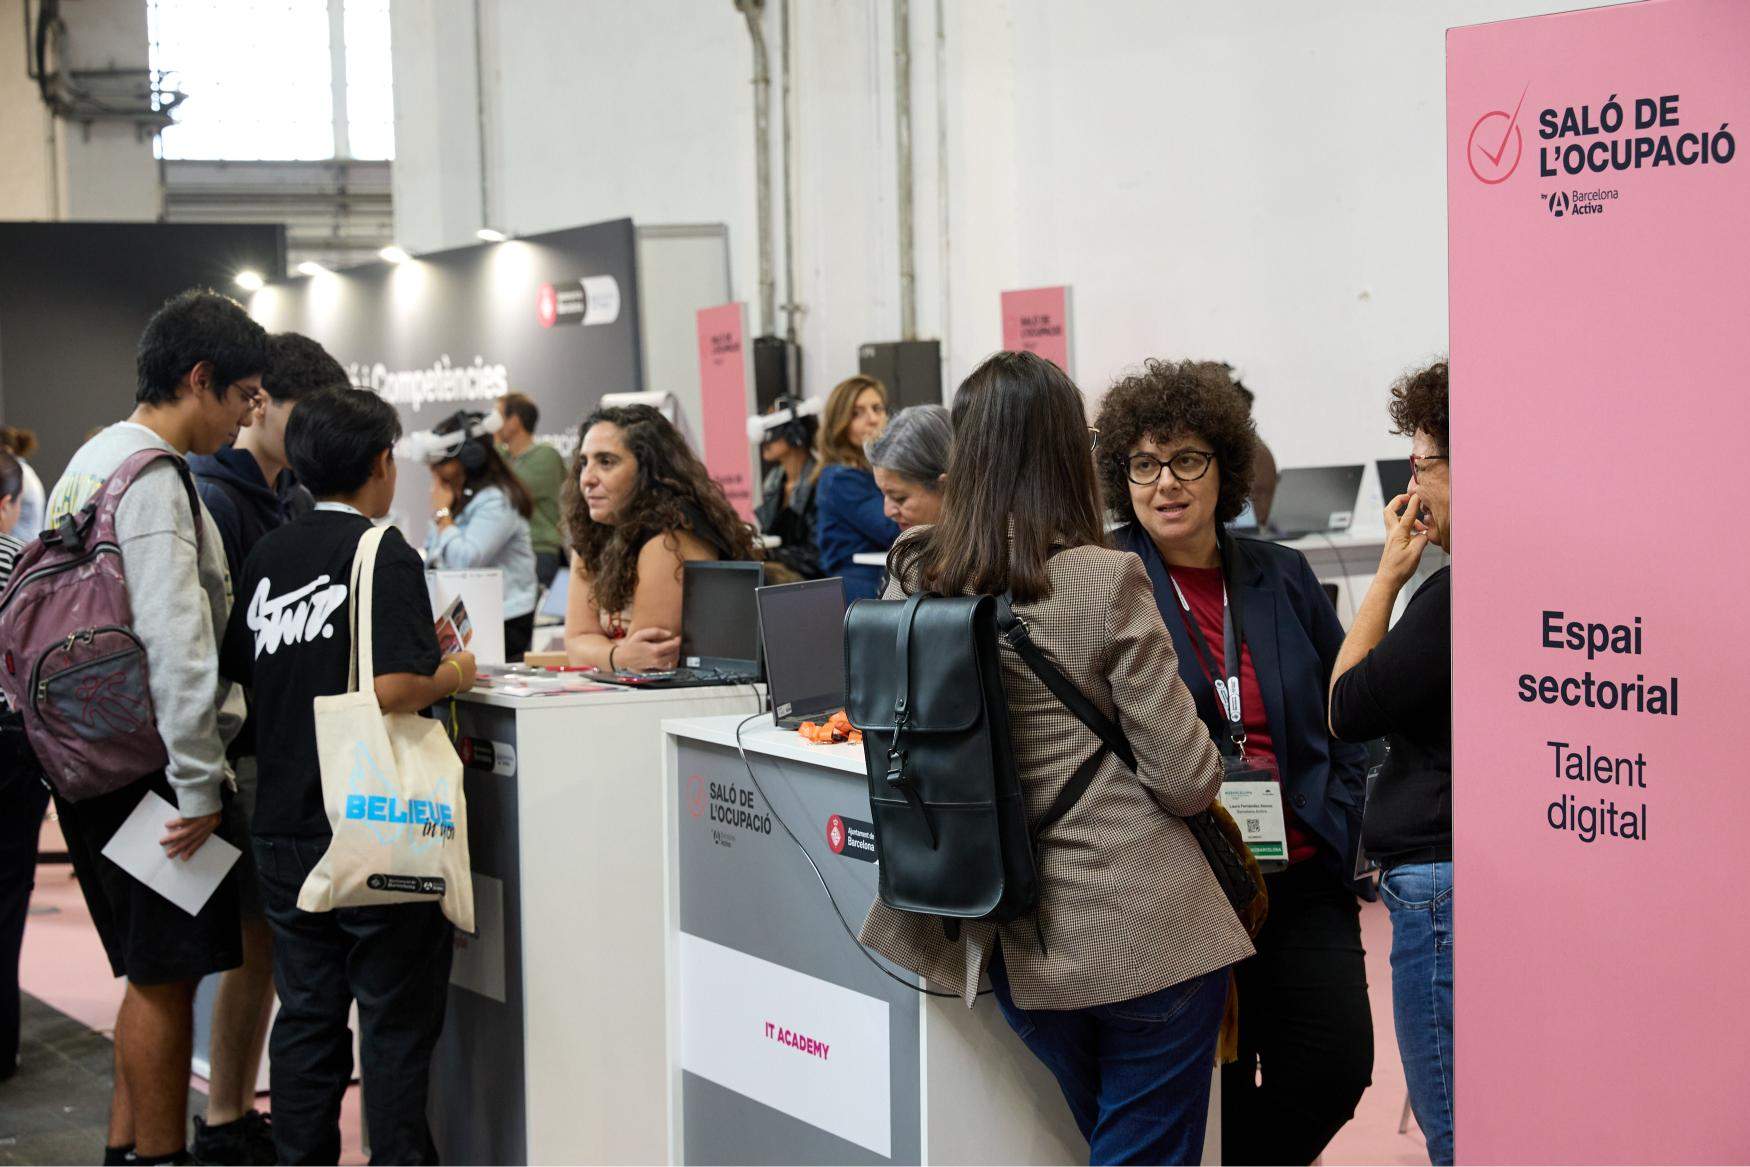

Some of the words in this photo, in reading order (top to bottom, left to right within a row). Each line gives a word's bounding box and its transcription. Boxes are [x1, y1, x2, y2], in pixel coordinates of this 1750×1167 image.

[1538, 93, 1624, 140] SALÓ
[1635, 94, 1680, 130] DE
[1539, 122, 1736, 178] L'OCUPACIÓ
[1572, 189, 1619, 202] Barcelona
[1572, 202, 1603, 215] Activa
[1542, 610, 1642, 660] Espai
[1517, 671, 1679, 716] sectorial
[1546, 741, 1647, 788] Talent
[710, 782, 737, 804] SALÓ
[740, 789, 754, 809] DE
[710, 803, 772, 835] L'OCUPACIÓ
[1546, 794, 1647, 843] digital
[847, 835, 875, 852] Barcelona
[764, 1021, 775, 1039] IT
[777, 1027, 830, 1061] ACADEMY
